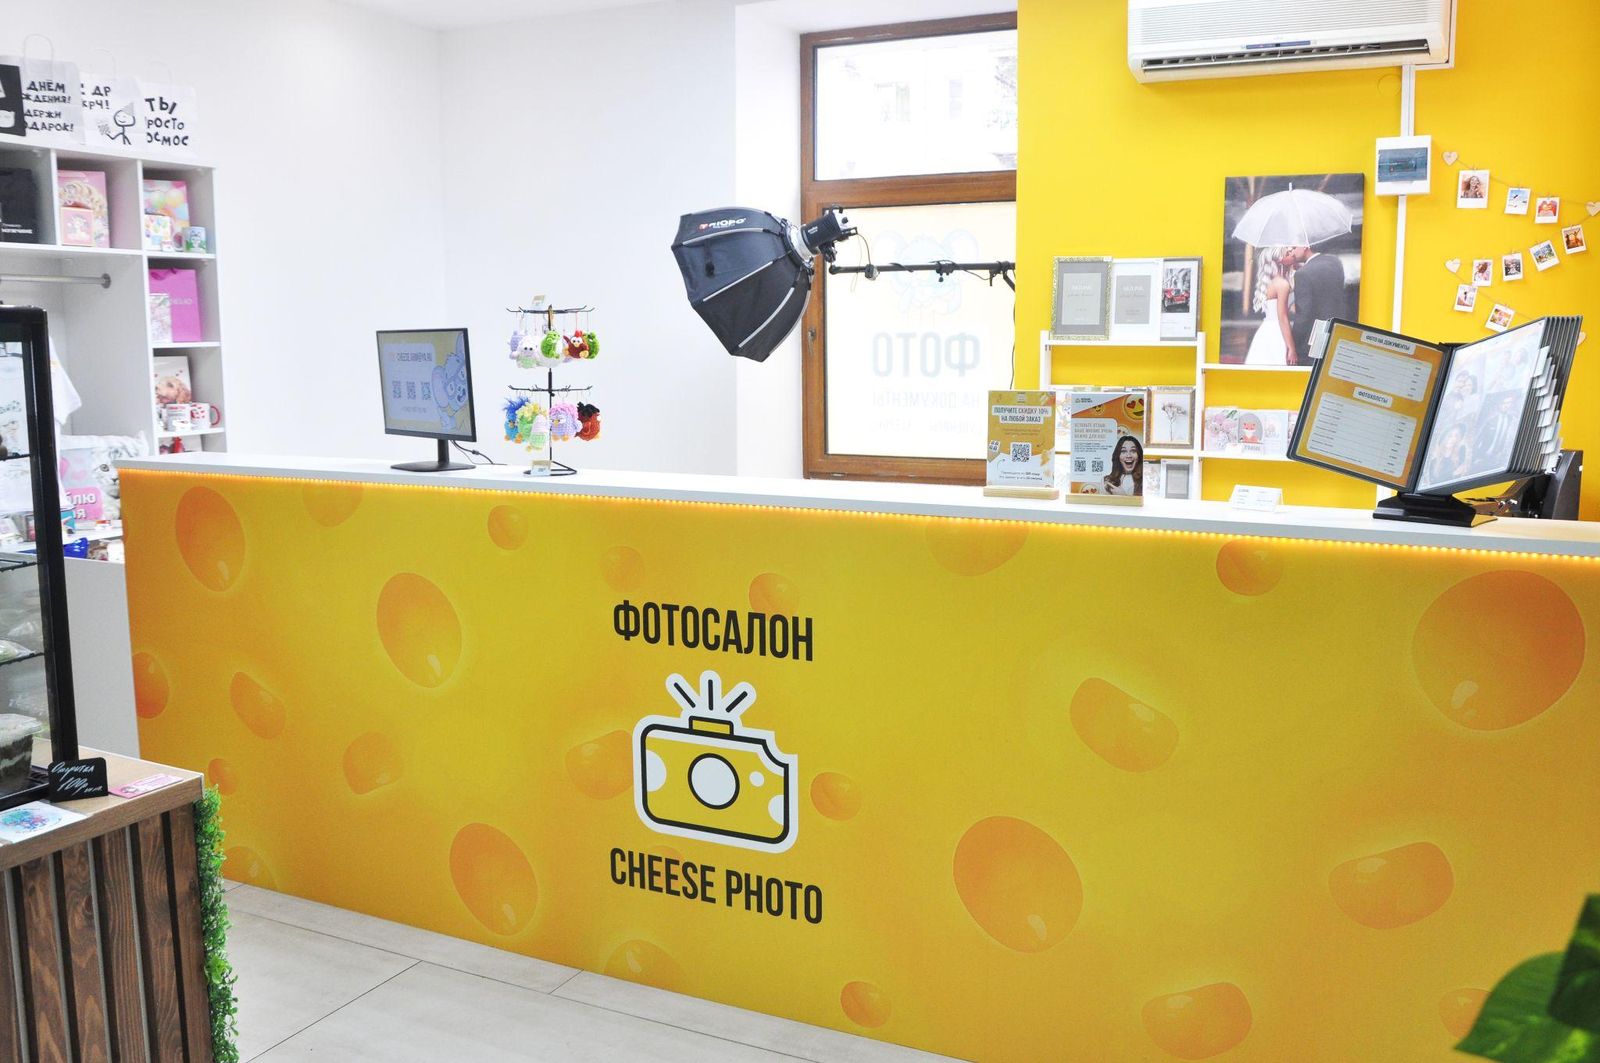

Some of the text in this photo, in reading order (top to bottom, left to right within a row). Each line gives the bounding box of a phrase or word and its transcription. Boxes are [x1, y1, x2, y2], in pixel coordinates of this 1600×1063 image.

[92, 85, 111, 97] ДР
[24, 109, 62, 119] ДЕРЖИ
[145, 96, 177, 115] ТЫ
[145, 116, 184, 131] РОСТО
[613, 600, 814, 662] ФОТОСАЛОН
[609, 847, 823, 924] CHEESE PHOTO
